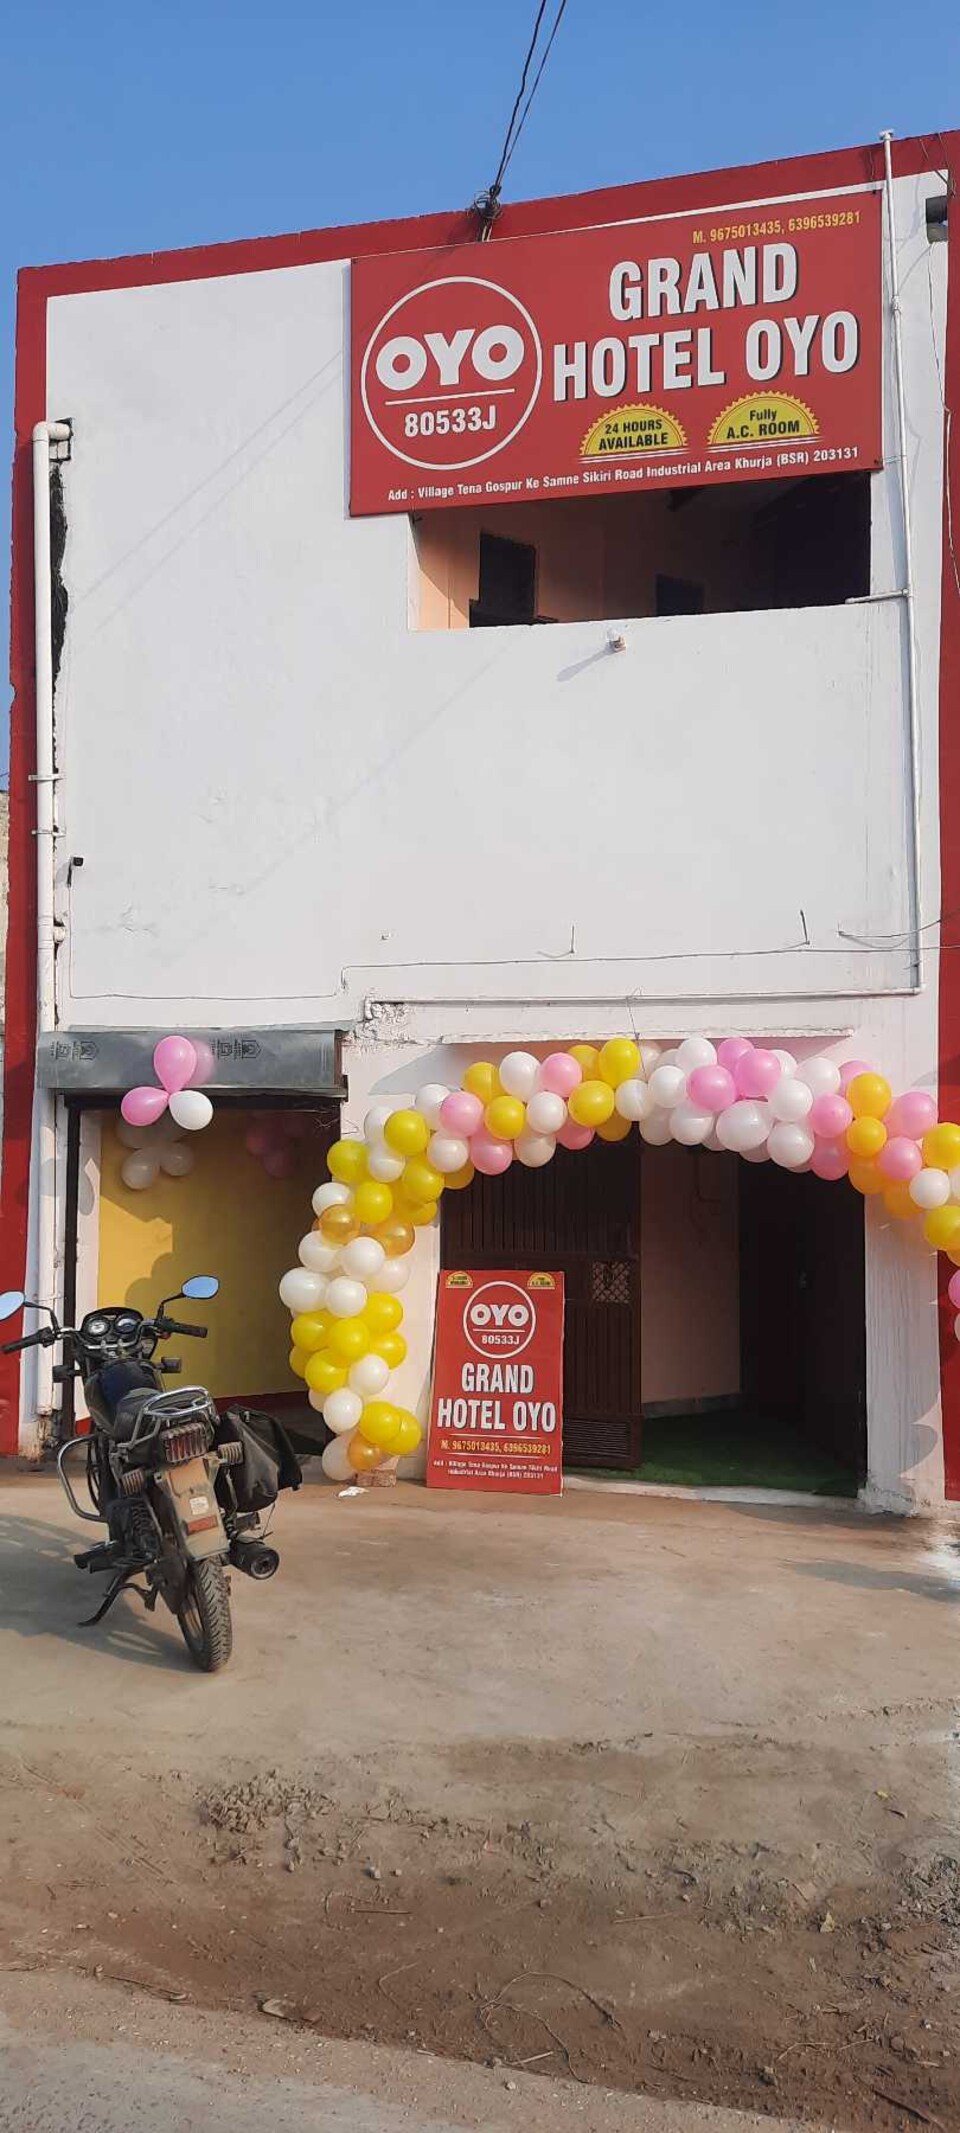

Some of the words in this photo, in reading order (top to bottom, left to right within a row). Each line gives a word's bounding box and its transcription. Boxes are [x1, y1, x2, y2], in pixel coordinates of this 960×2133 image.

[692, 230, 706, 244] M.
[710, 220, 785, 242] 9675013435,
[788, 211, 861, 232] 6396539281
[608, 242, 798, 322] GRAND
[375, 325, 525, 391] OYO
[553, 328, 726, 403] HOTEL
[745, 311, 860, 383] OYO
[404, 405, 496, 438] 80533J
[605, 424, 619, 435] 24
[623, 419, 663, 432] HOURS
[726, 425, 754, 440] A.C.
[759, 420, 800, 436] ROOM
[750, 408, 777, 421] Fully
[598, 432, 669, 450] AVAILABLE
[388, 489, 407, 501] Add
[418, 487, 454, 499] Village
[458, 484, 482, 495] Tena
[485, 481, 522, 495] Gospur
[526, 478, 539, 489] Ke
[543, 474, 579, 487] Samne
[583, 469, 611, 483] Sikiri
[615, 469, 643, 480] Road
[647, 461, 701, 477] Industrial
[705, 461, 731, 472] Area
[735, 457, 773, 470] Khurja
[776, 453, 809, 468] (BSR)
[813, 447, 858, 462] 203131
[470, 1303, 529, 1326] OYO
[481, 1335, 520, 1345] 80533J
[462, 1362, 534, 1394] GRAND
[437, 1398, 506, 1430] HOTEL
[513, 1401, 556, 1433] OYO
